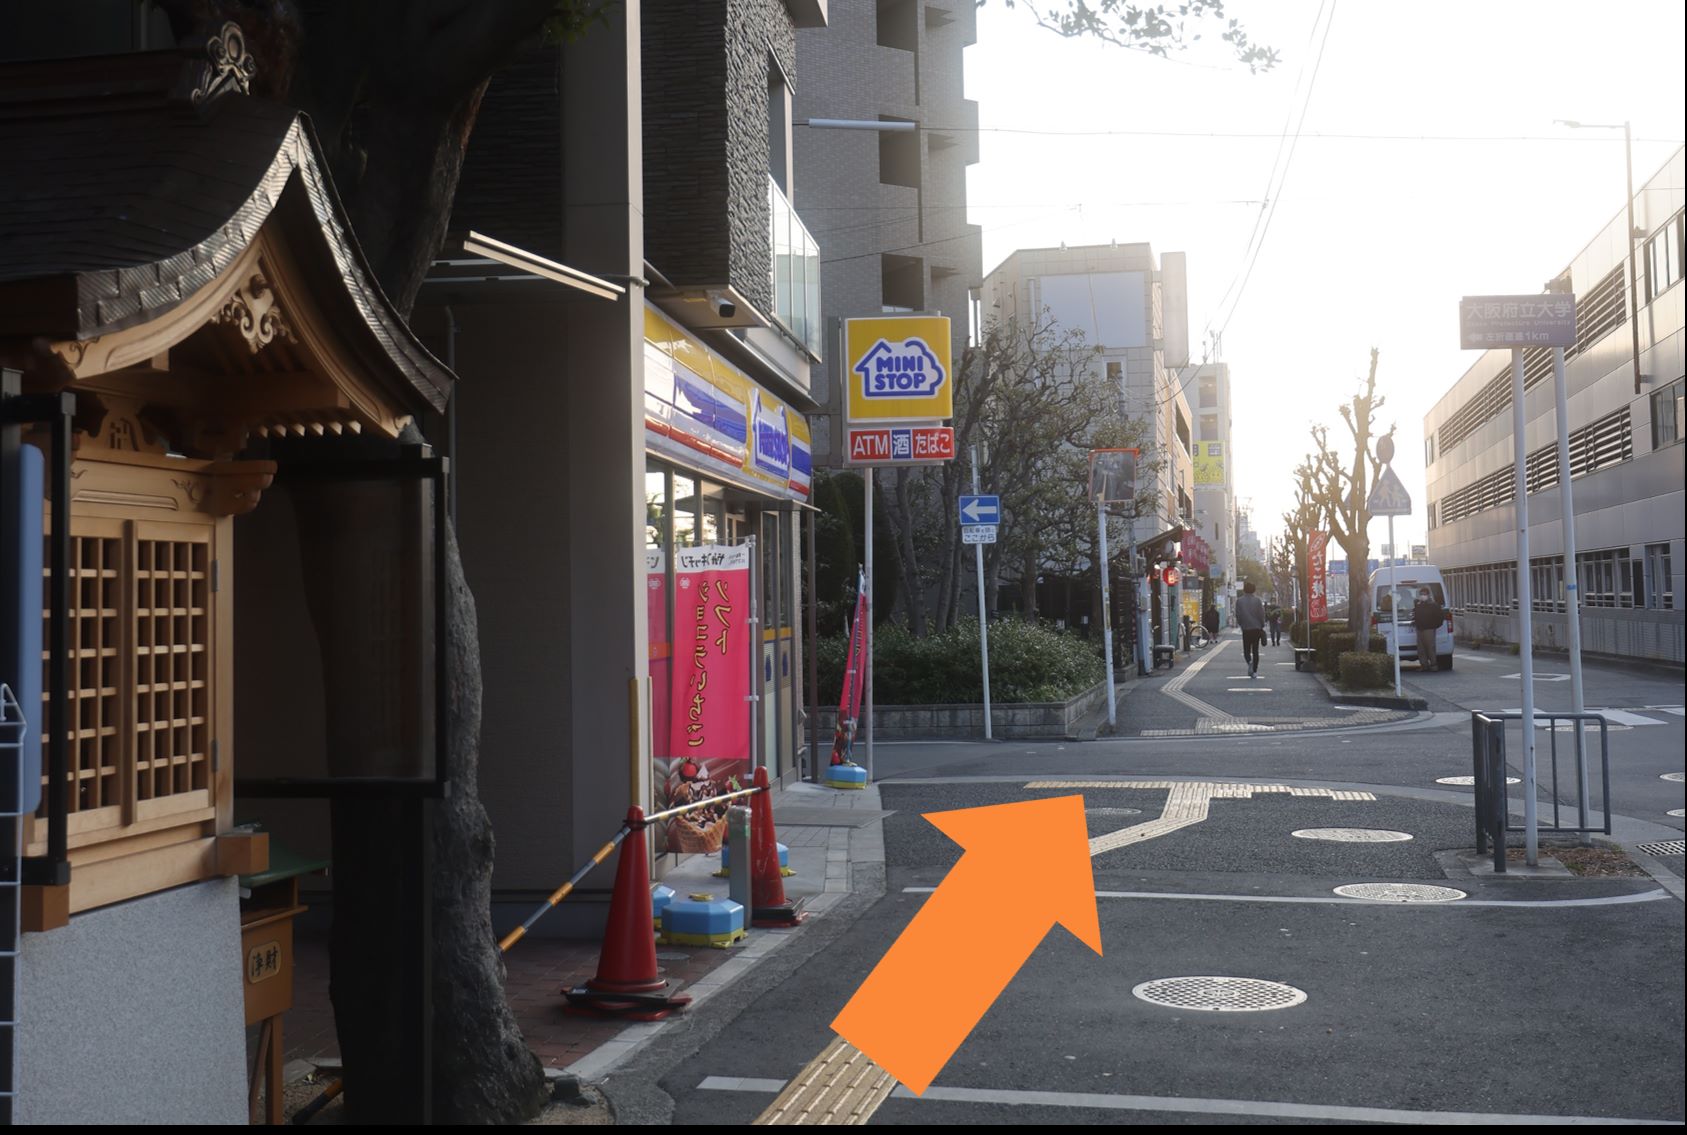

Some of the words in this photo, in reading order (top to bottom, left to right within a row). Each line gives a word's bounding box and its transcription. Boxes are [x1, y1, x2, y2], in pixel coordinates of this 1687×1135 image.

[1466, 301, 1572, 319] 大阪府立大学
[875, 356, 924, 373] MINI
[874, 372, 927, 390] STOP
[853, 434, 889, 456] ATM
[893, 433, 910, 456] 酒
[915, 432, 951, 455] たばこ
